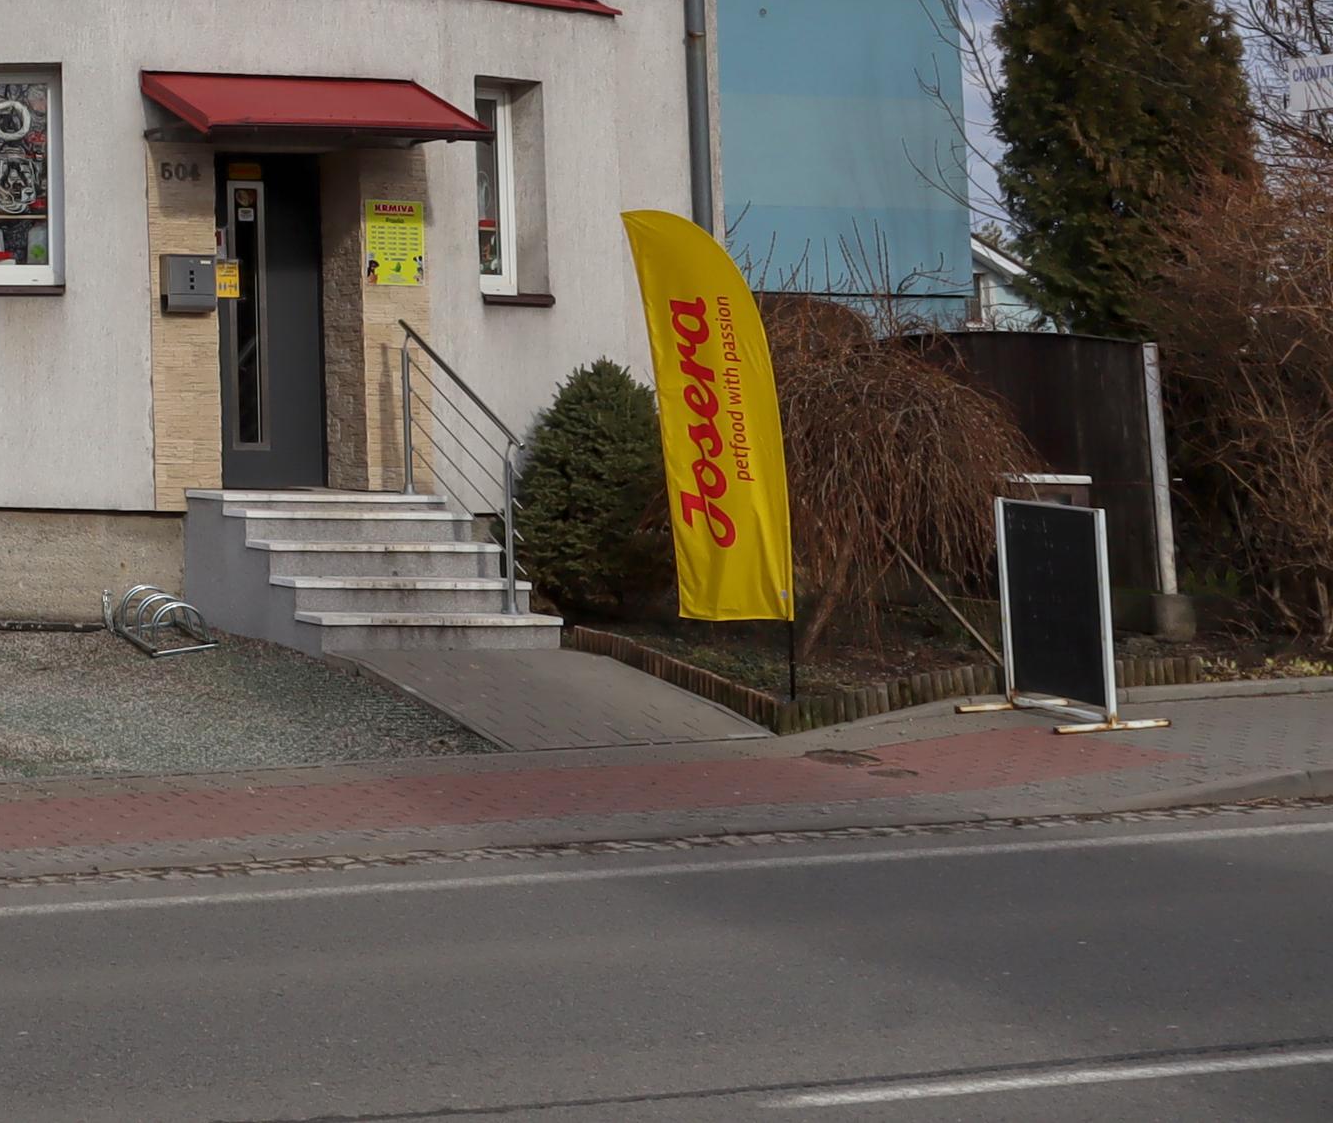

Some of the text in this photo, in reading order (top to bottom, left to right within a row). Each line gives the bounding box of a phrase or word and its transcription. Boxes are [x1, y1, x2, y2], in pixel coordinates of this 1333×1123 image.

[374, 204, 415, 213] KRMIVA
[669, 296, 737, 549] Josera
[716, 295, 754, 482] petfood with passion
